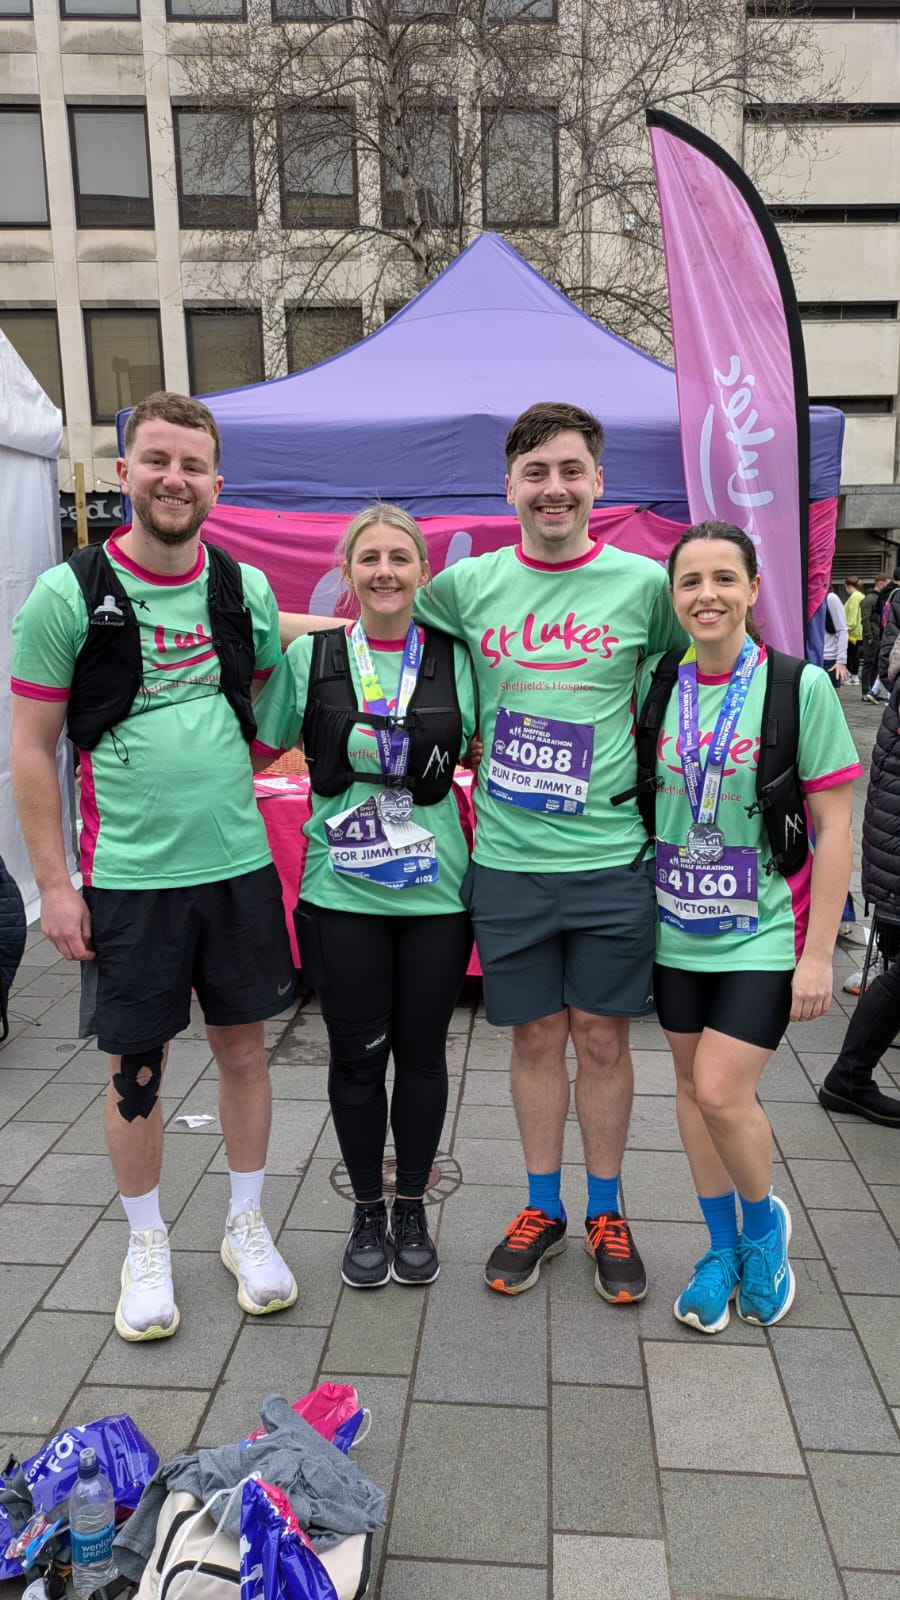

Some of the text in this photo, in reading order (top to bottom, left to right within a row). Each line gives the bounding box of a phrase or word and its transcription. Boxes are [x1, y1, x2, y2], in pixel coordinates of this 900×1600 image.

[480, 612, 620, 669] St Luke's
[500, 681, 595, 692] Sheffield's Hospice
[536, 736, 573, 748] MARATHON
[505, 739, 573, 773] 4088
[491, 766, 583, 796] RUN FOR JIMMY B
[334, 842, 432, 862] FOR JIMMY B XX
[695, 864, 735, 872] MARATHON
[415, 875, 433, 884] 4102
[668, 869, 737, 897] 4160
[673, 899, 732, 915] VICTORIA
